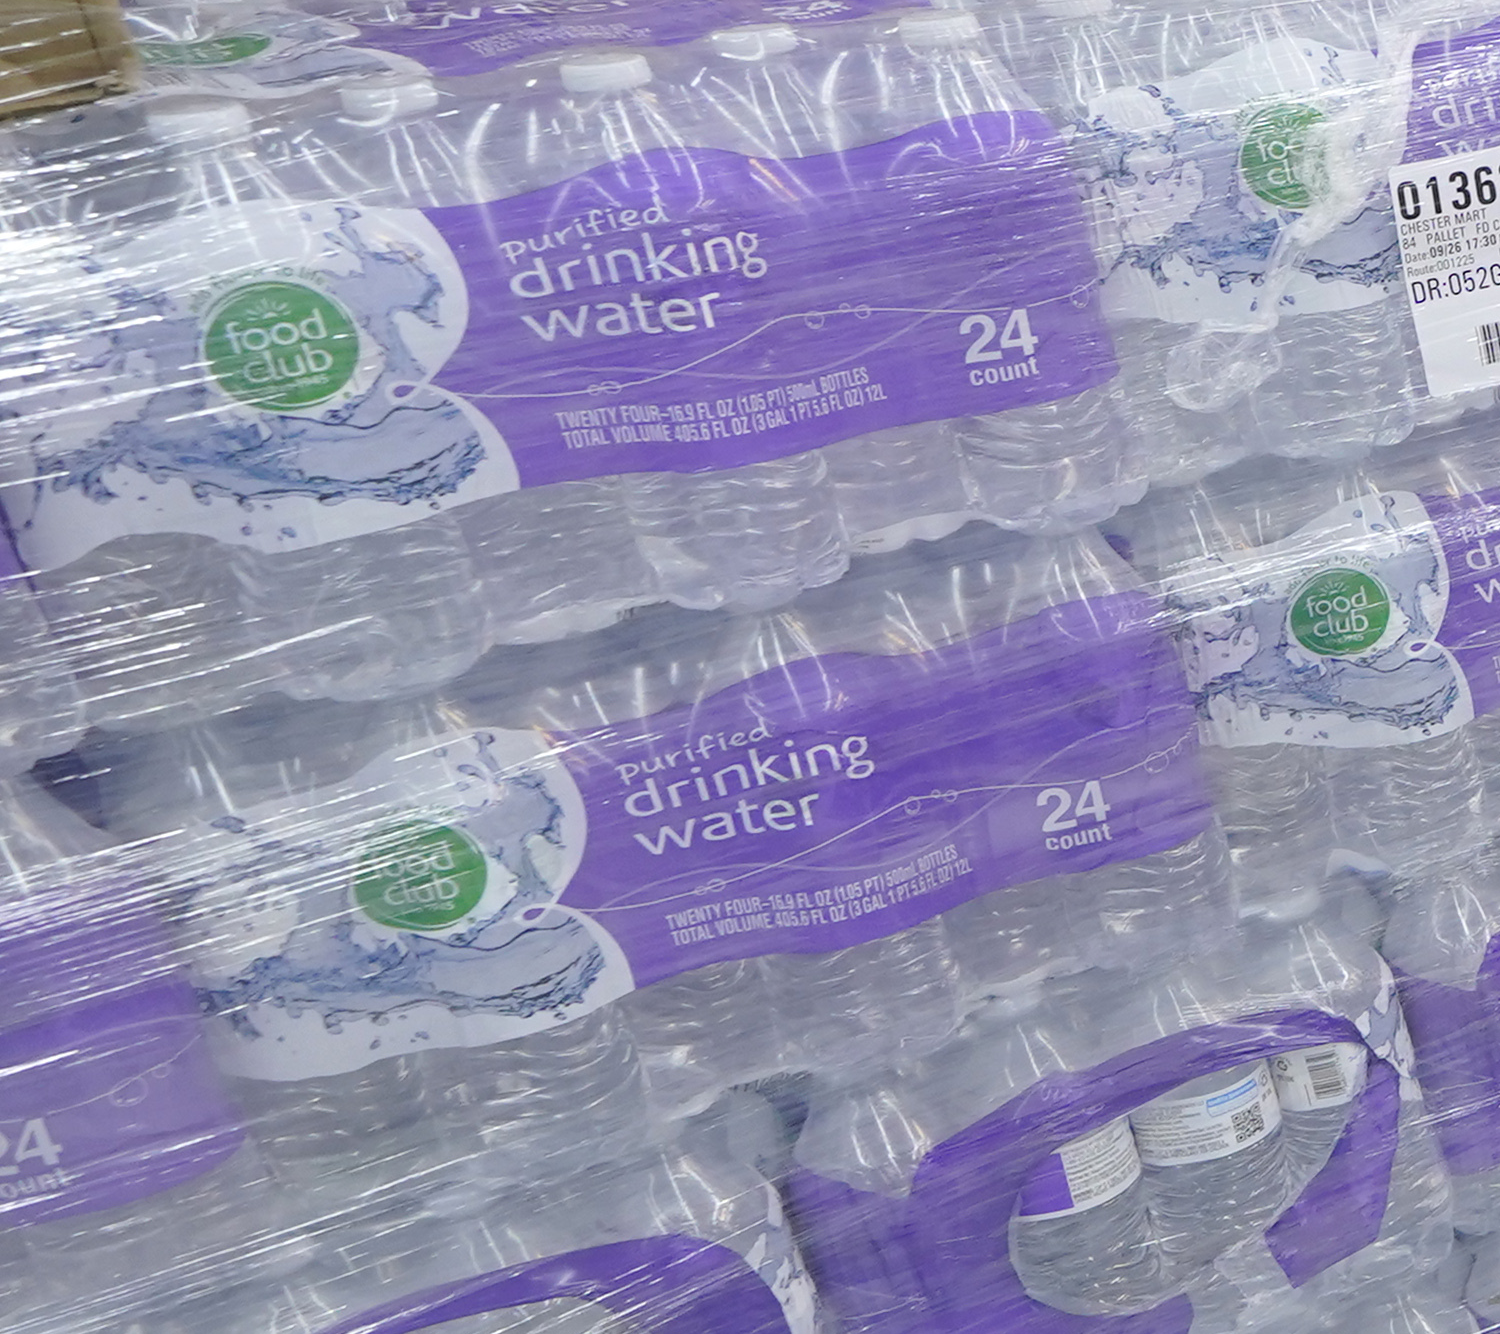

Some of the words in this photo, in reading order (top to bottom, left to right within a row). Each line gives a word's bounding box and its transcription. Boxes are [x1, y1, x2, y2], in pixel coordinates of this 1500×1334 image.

[500, 203, 670, 266] purified
[1400, 216, 1452, 238] CHESTER
[1454, 207, 1488, 227] MART
[1402, 235, 1418, 250] 84
[1426, 226, 1466, 246] PALLET
[1475, 220, 1490, 235] FD
[1465, 234, 1498, 253] 17:30
[509, 228, 768, 300] drinking
[225, 308, 327, 355] food
[519, 291, 721, 344] water
[958, 308, 1039, 367] 24
[243, 342, 334, 383] club
[969, 356, 1040, 388] count
[554, 407, 618, 431] TWENTY
[697, 402, 715, 421] FL
[717, 399, 735, 418] OZ
[820, 366, 870, 396] BOTTLES
[562, 426, 611, 450] TOTAL
[610, 421, 674, 445] VOLUME
[712, 419, 730, 440] FL
[731, 416, 753, 437] OZ
[1305, 584, 1369, 618] food
[1314, 606, 1370, 639] club
[615, 724, 774, 784] purified
[623, 732, 875, 818] drinking
[634, 794, 821, 855] water
[1034, 780, 1111, 833] 24
[1045, 823, 1112, 852] count
